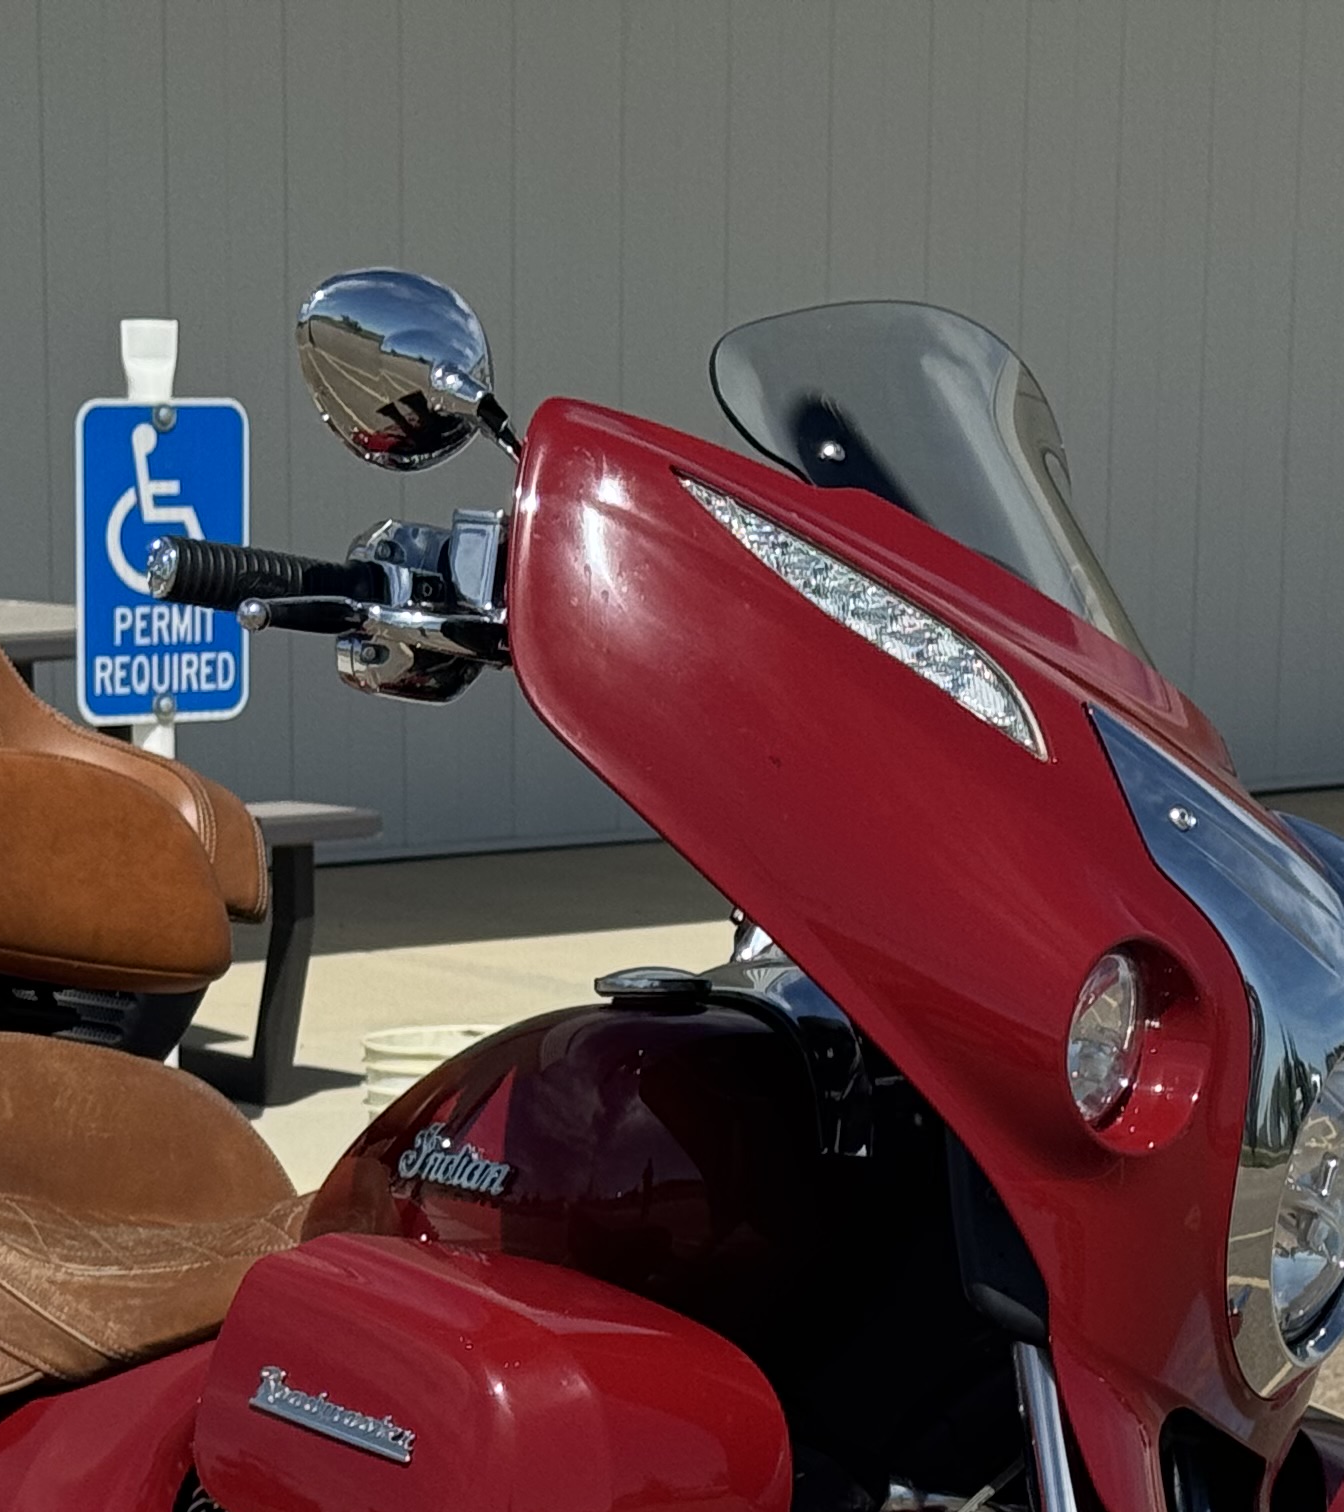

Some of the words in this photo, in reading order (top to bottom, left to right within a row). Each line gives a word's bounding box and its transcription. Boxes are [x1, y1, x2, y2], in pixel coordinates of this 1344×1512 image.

[113, 604, 214, 647] PERMIT
[94, 651, 235, 696] REQUIRED
[398, 1122, 511, 1196] Indian
